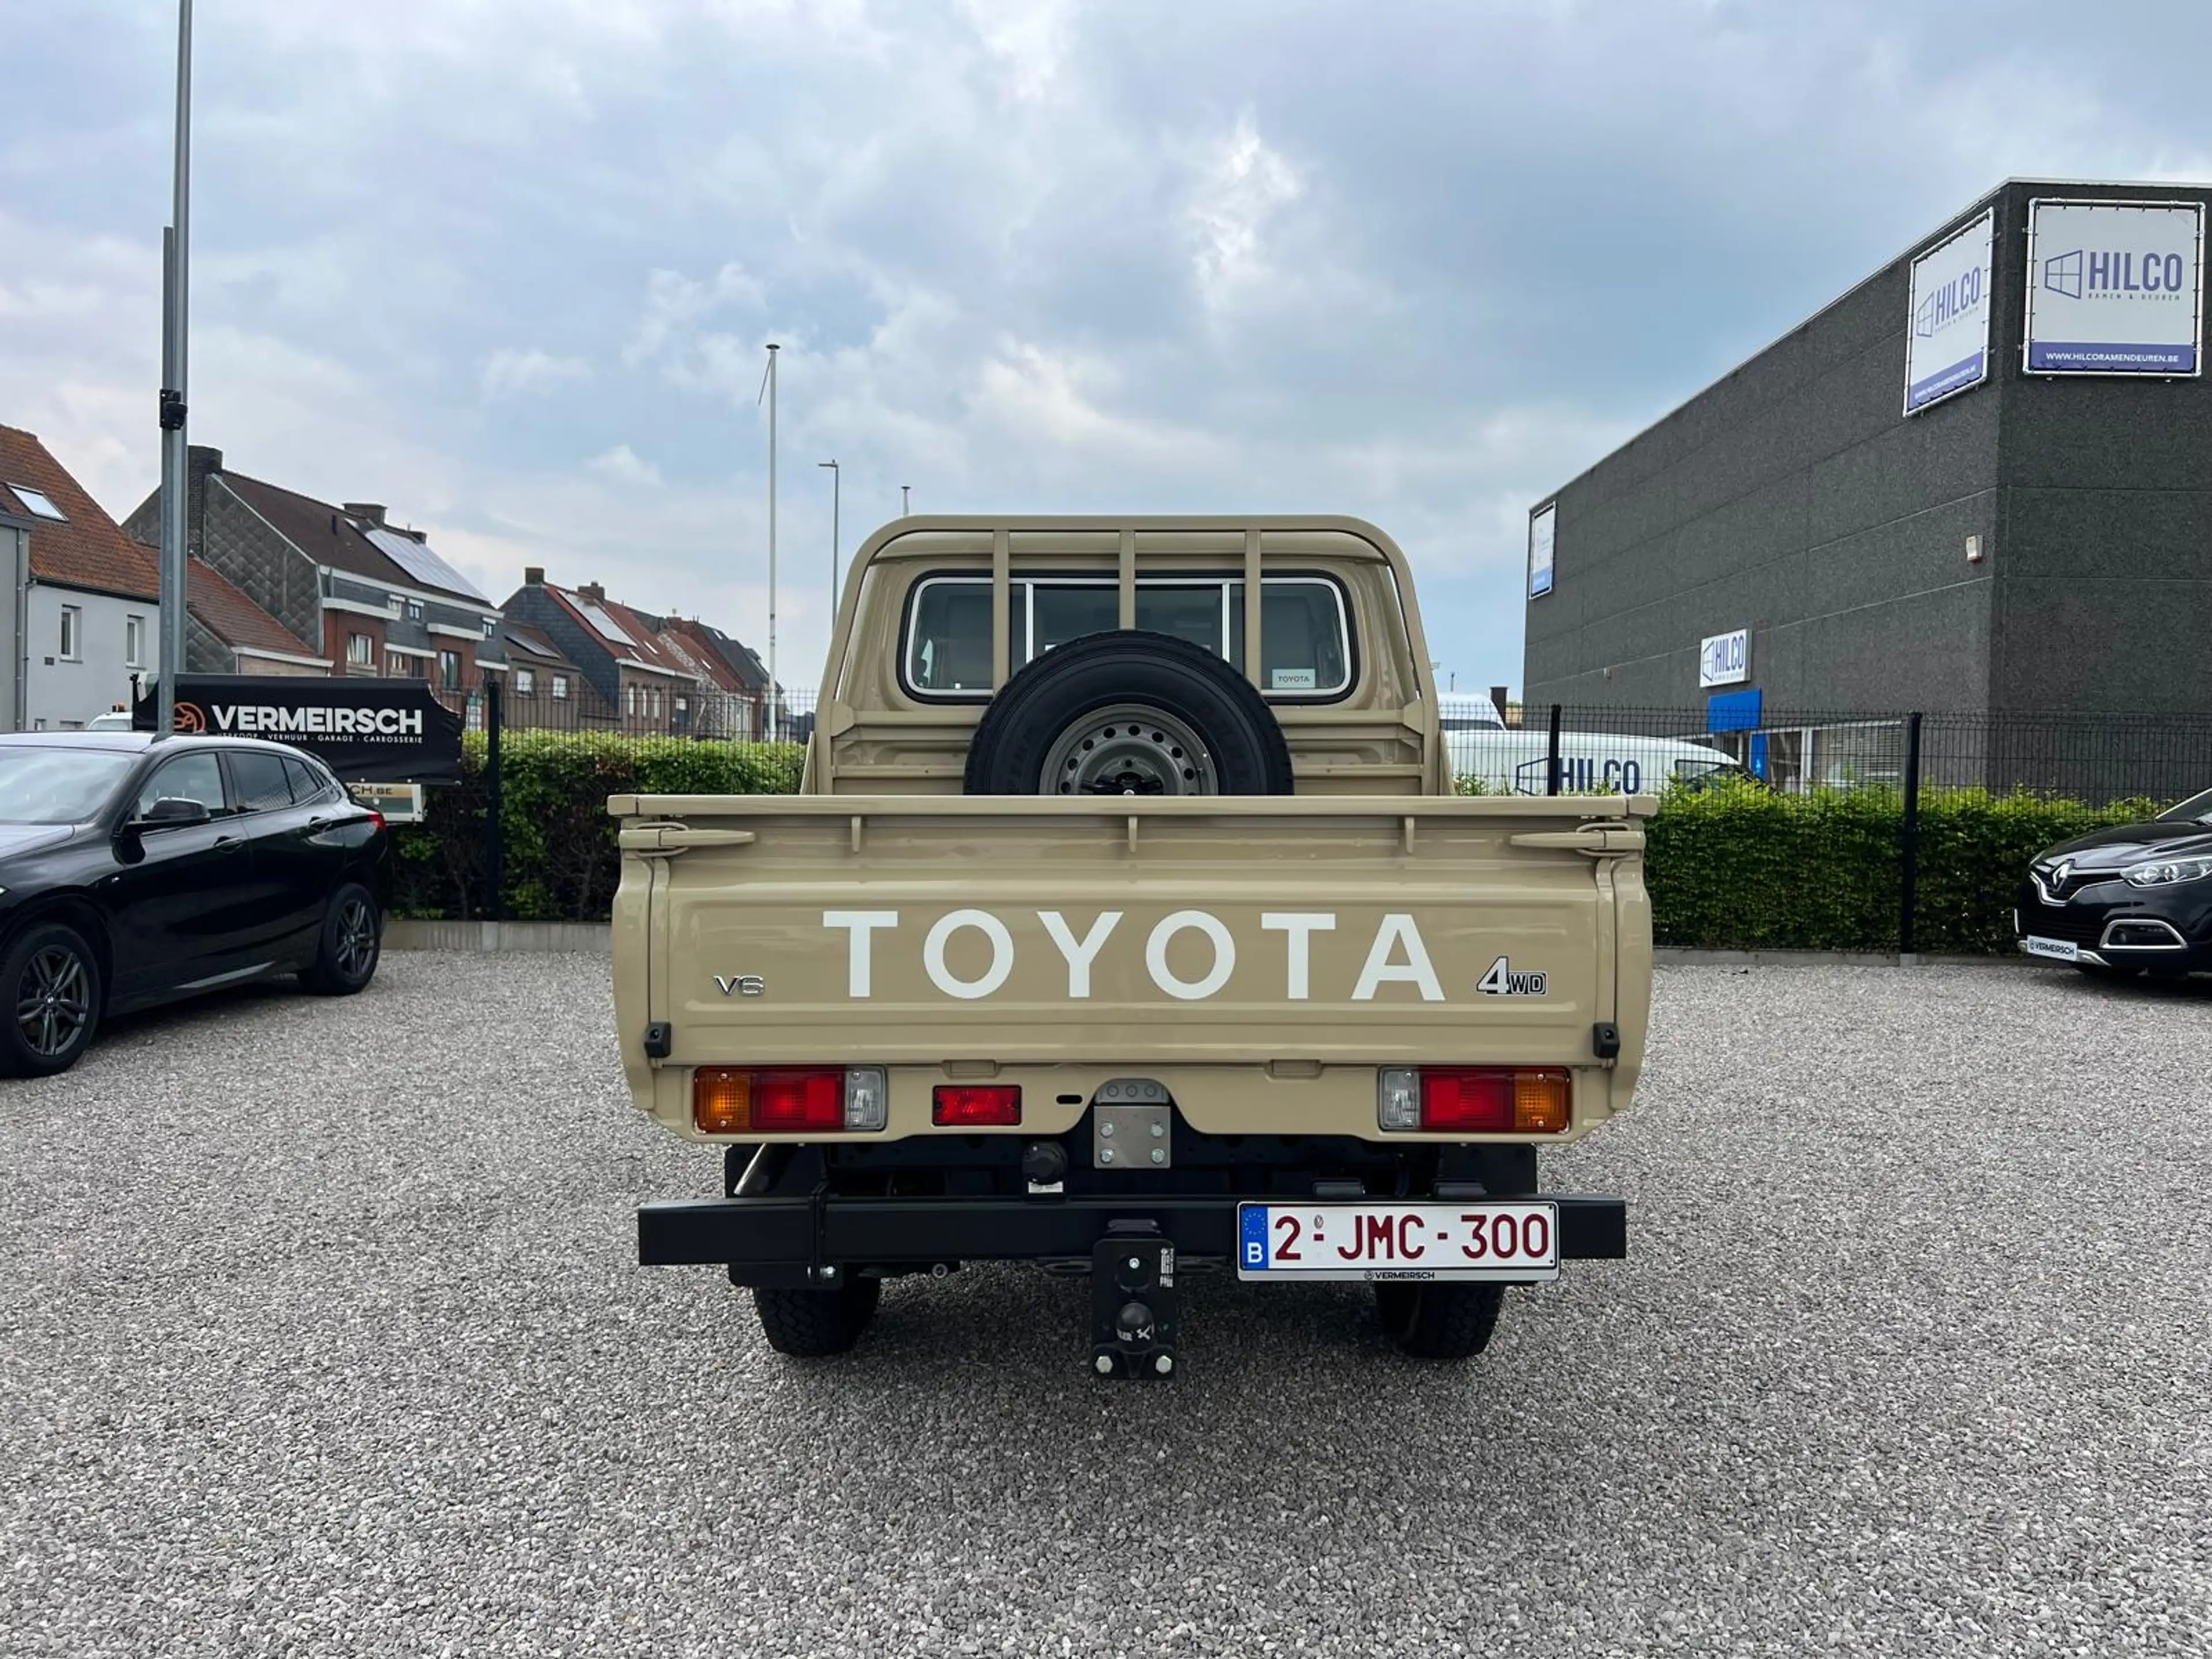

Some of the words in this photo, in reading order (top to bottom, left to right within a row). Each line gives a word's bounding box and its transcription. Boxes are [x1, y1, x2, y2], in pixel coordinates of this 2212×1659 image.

[2089, 252, 2183, 291] HILCO
[1935, 266, 1980, 325] HILCO
[1715, 635, 1744, 673] HILCO
[211, 705, 422, 734] VERMEIRSCH
[363, 736, 422, 744] CARROSSERIE
[1558, 758, 1640, 794] HILCO
[823, 908, 1445, 1001] TOYOTA
[1476, 955, 1547, 995] 4WD
[1247, 1241, 1263, 1263] B
